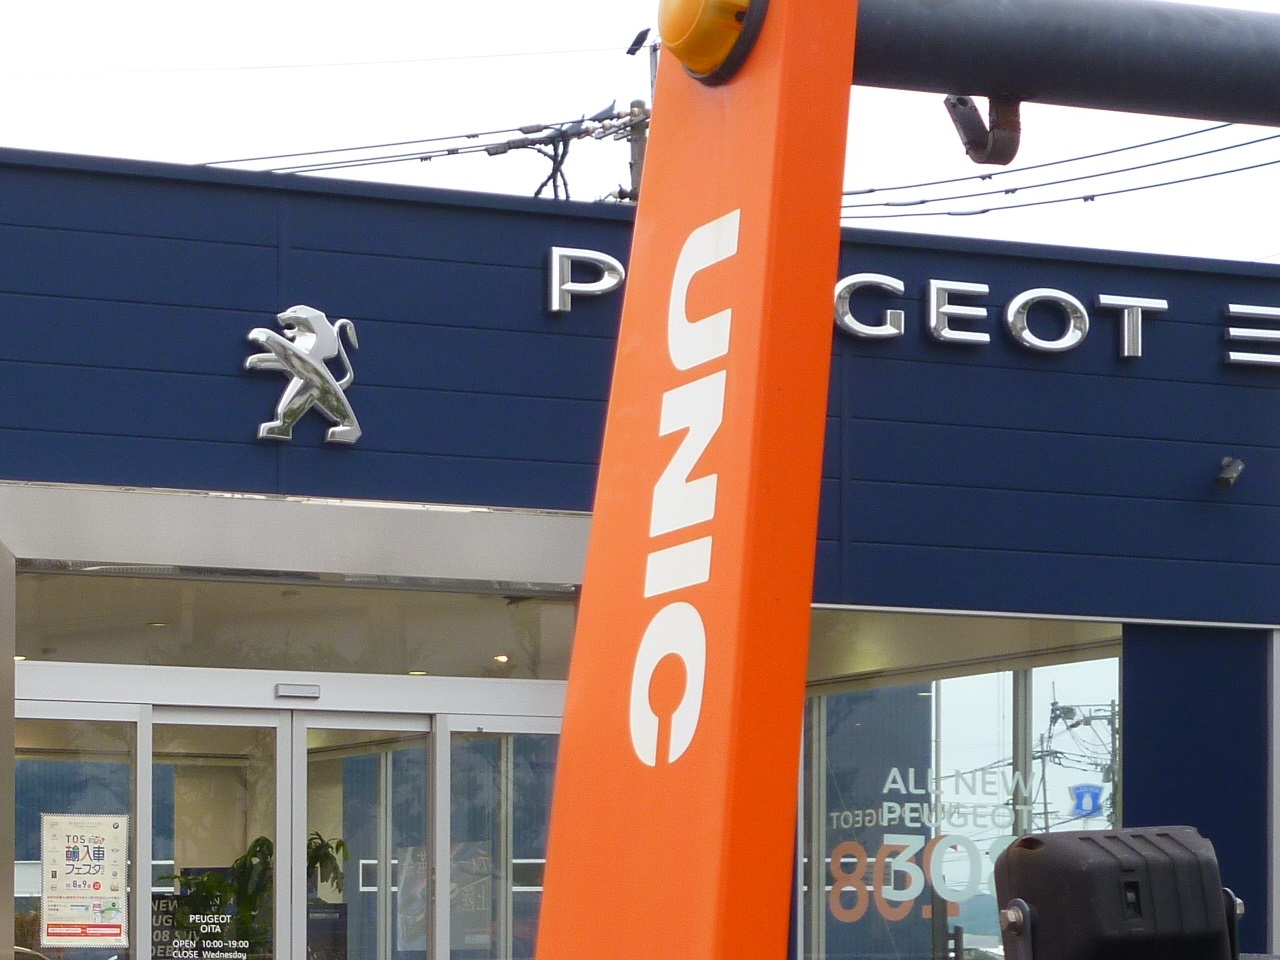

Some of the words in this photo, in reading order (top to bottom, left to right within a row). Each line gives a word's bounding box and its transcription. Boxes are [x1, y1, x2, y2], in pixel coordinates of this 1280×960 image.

[550, 246, 1169, 358] PGEOT
[630, 208, 741, 767] UNIC
[882, 767, 944, 795] ALL
[954, 769, 1035, 798] NEW
[882, 801, 1035, 831] PEUGEOT
[65, 834, 86, 844] TOS
[65, 863, 101, 875] フェスタ
[881, 833, 1017, 902] 30
[189, 914, 232, 923] PEUGEOT
[200, 924, 222, 933] OITA
[172, 939, 196, 948] OPEN
[172, 950, 199, 959] CLOSE
[202, 950, 247, 960] Wednesday
